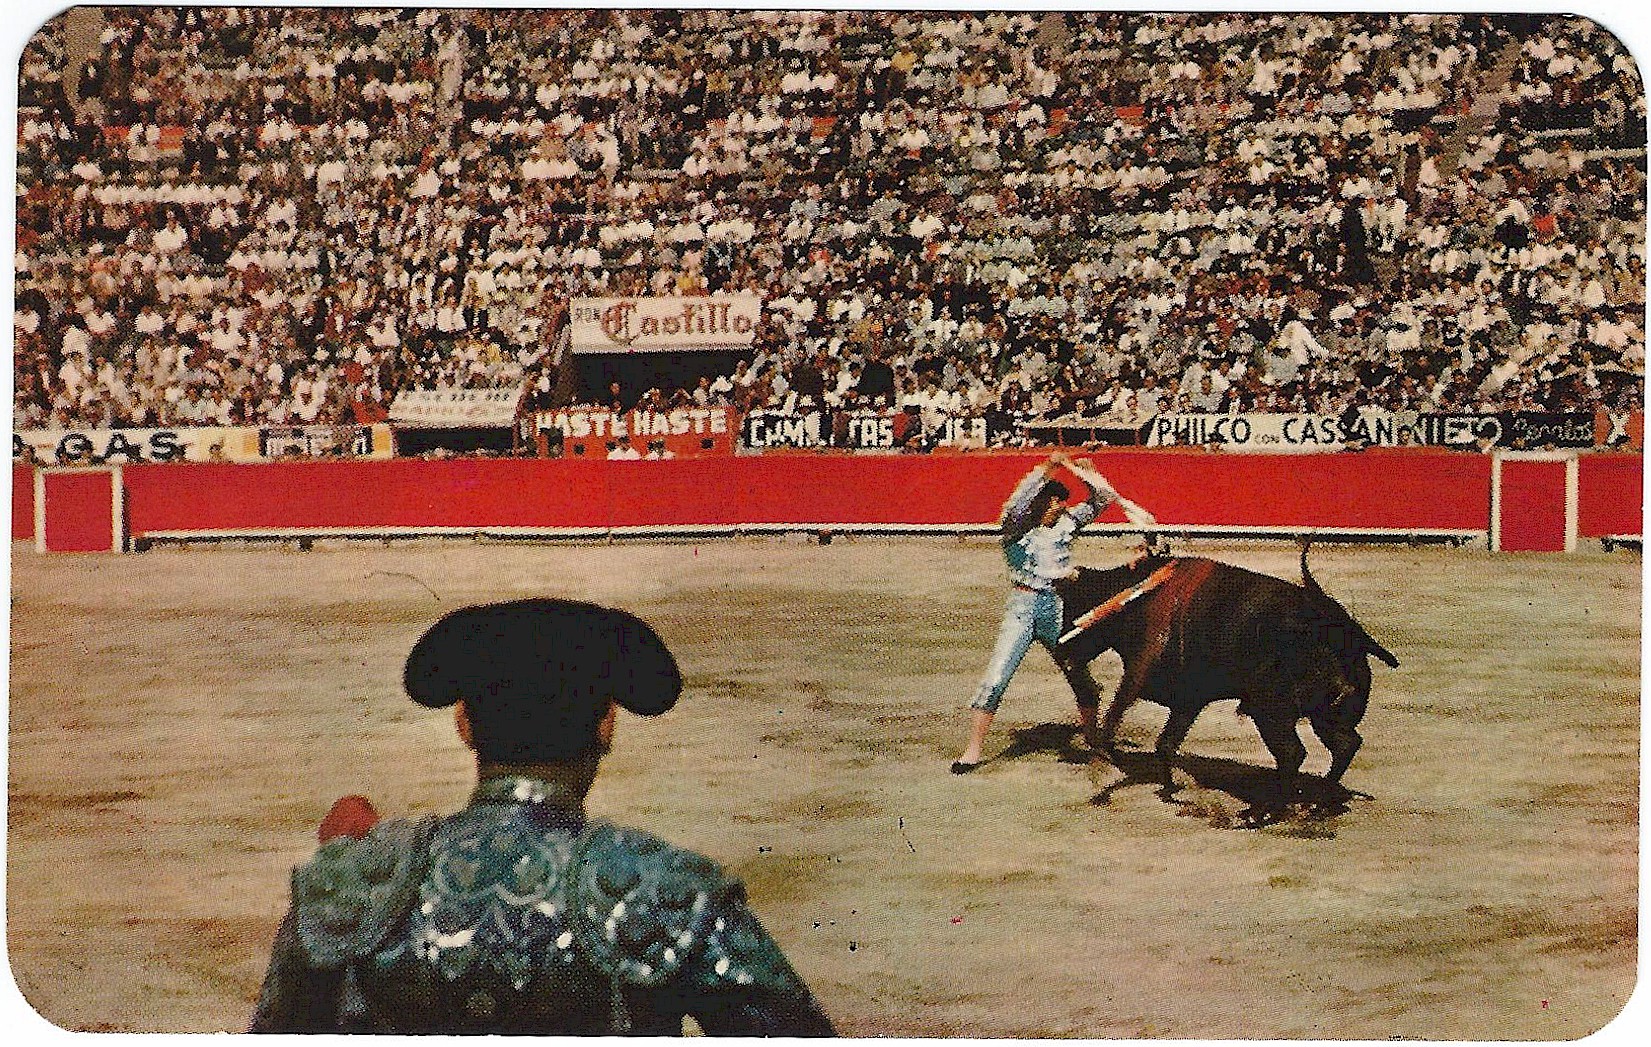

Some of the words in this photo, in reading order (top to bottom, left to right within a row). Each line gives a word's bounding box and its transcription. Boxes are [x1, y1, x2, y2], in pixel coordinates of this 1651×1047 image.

[601, 301, 752, 346] Castillo
[634, 410, 727, 435] HASTE
[1156, 418, 1251, 444] PHILCO
